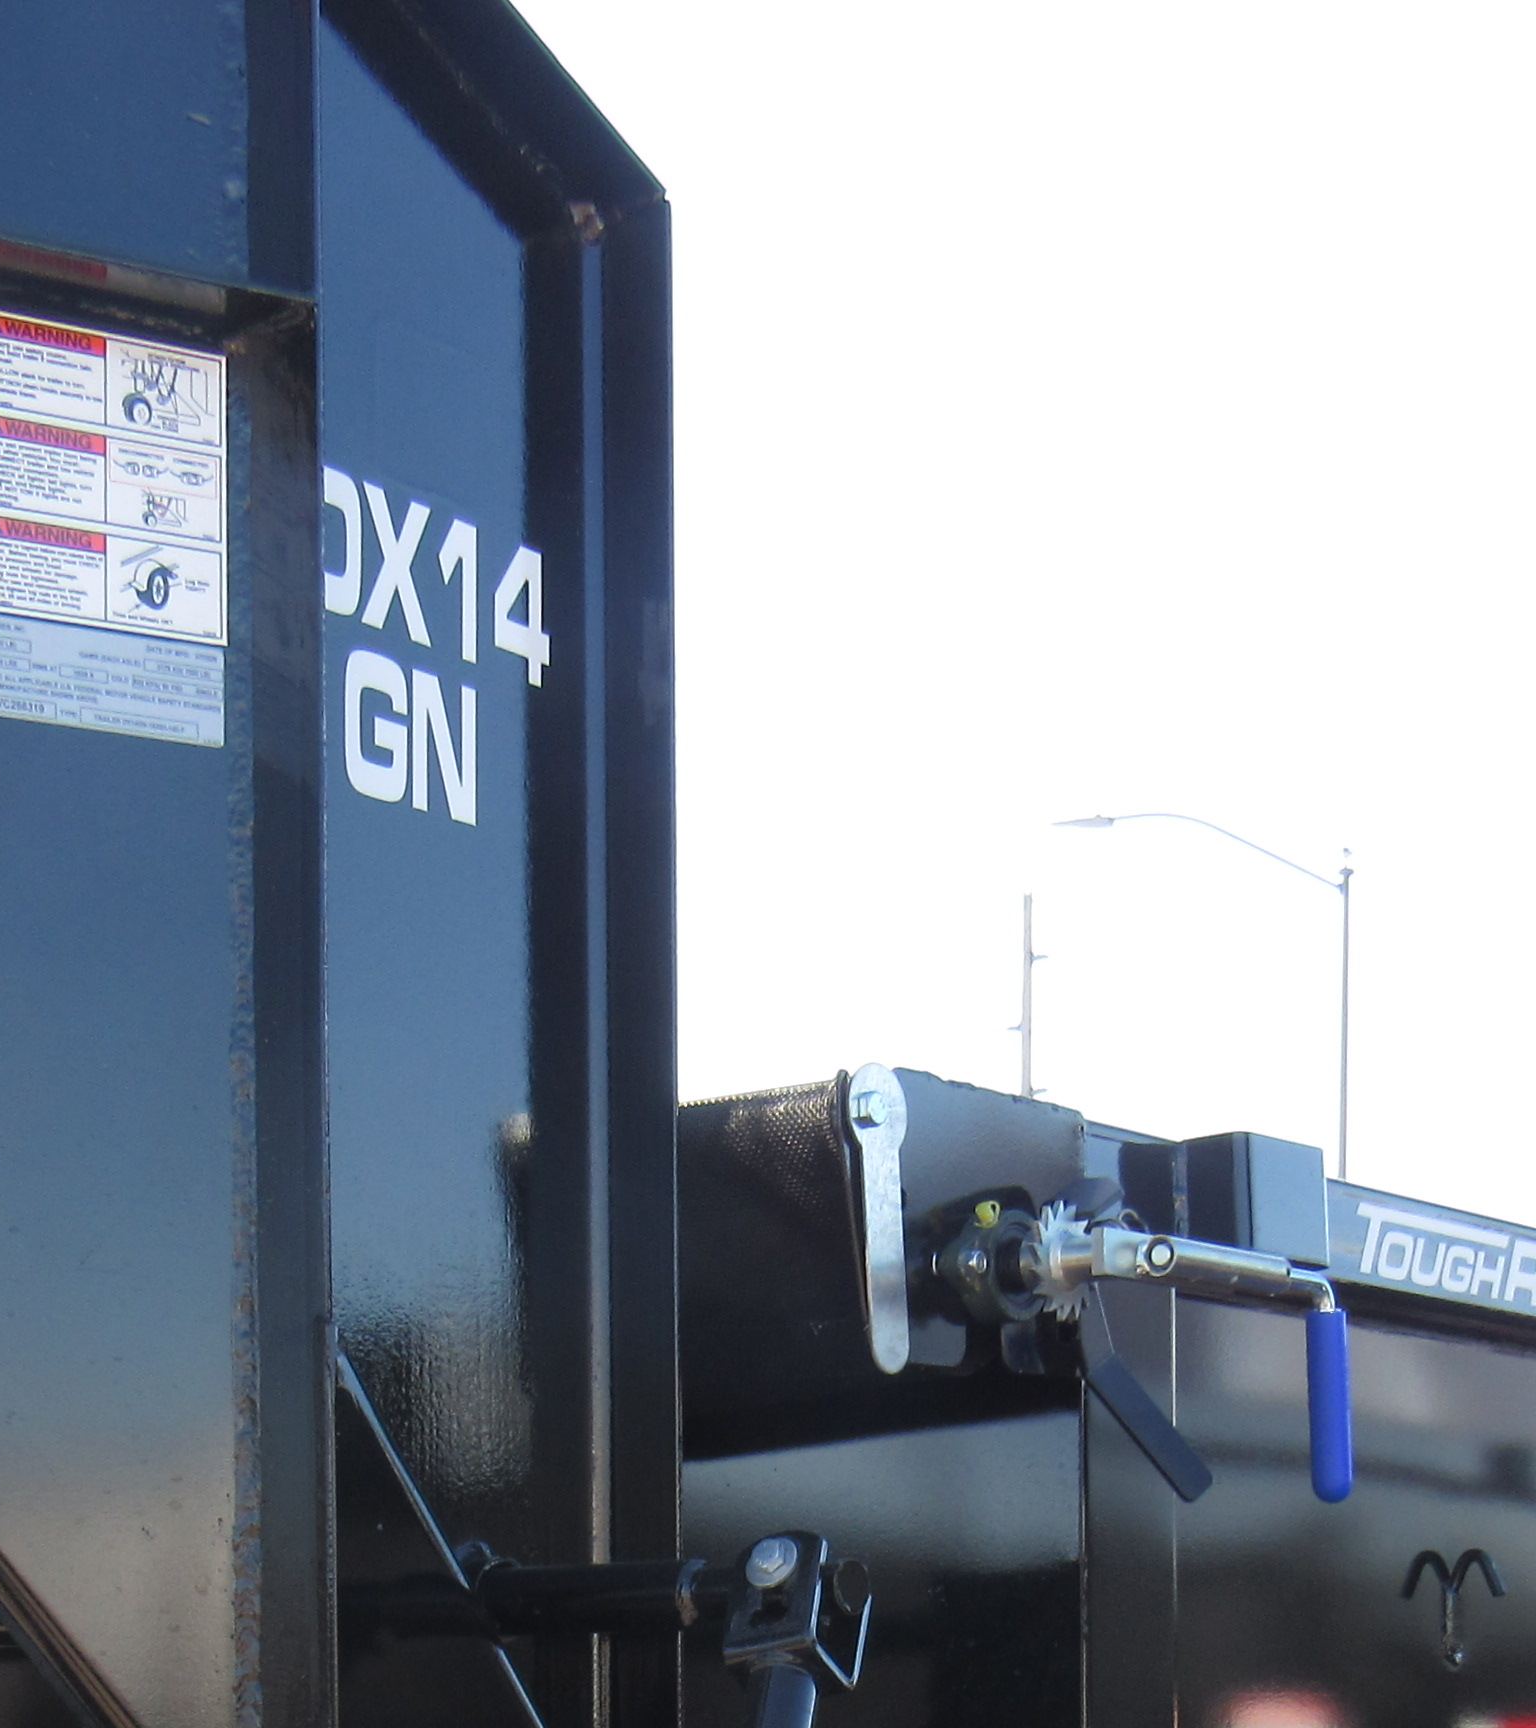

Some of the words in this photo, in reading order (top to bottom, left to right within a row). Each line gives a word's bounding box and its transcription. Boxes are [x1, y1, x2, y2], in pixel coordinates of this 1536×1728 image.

[5, 319, 92, 350] WARNING
[5, 419, 92, 450] WARNING
[5, 519, 92, 550] WARNING
[345, 648, 477, 827] GN
